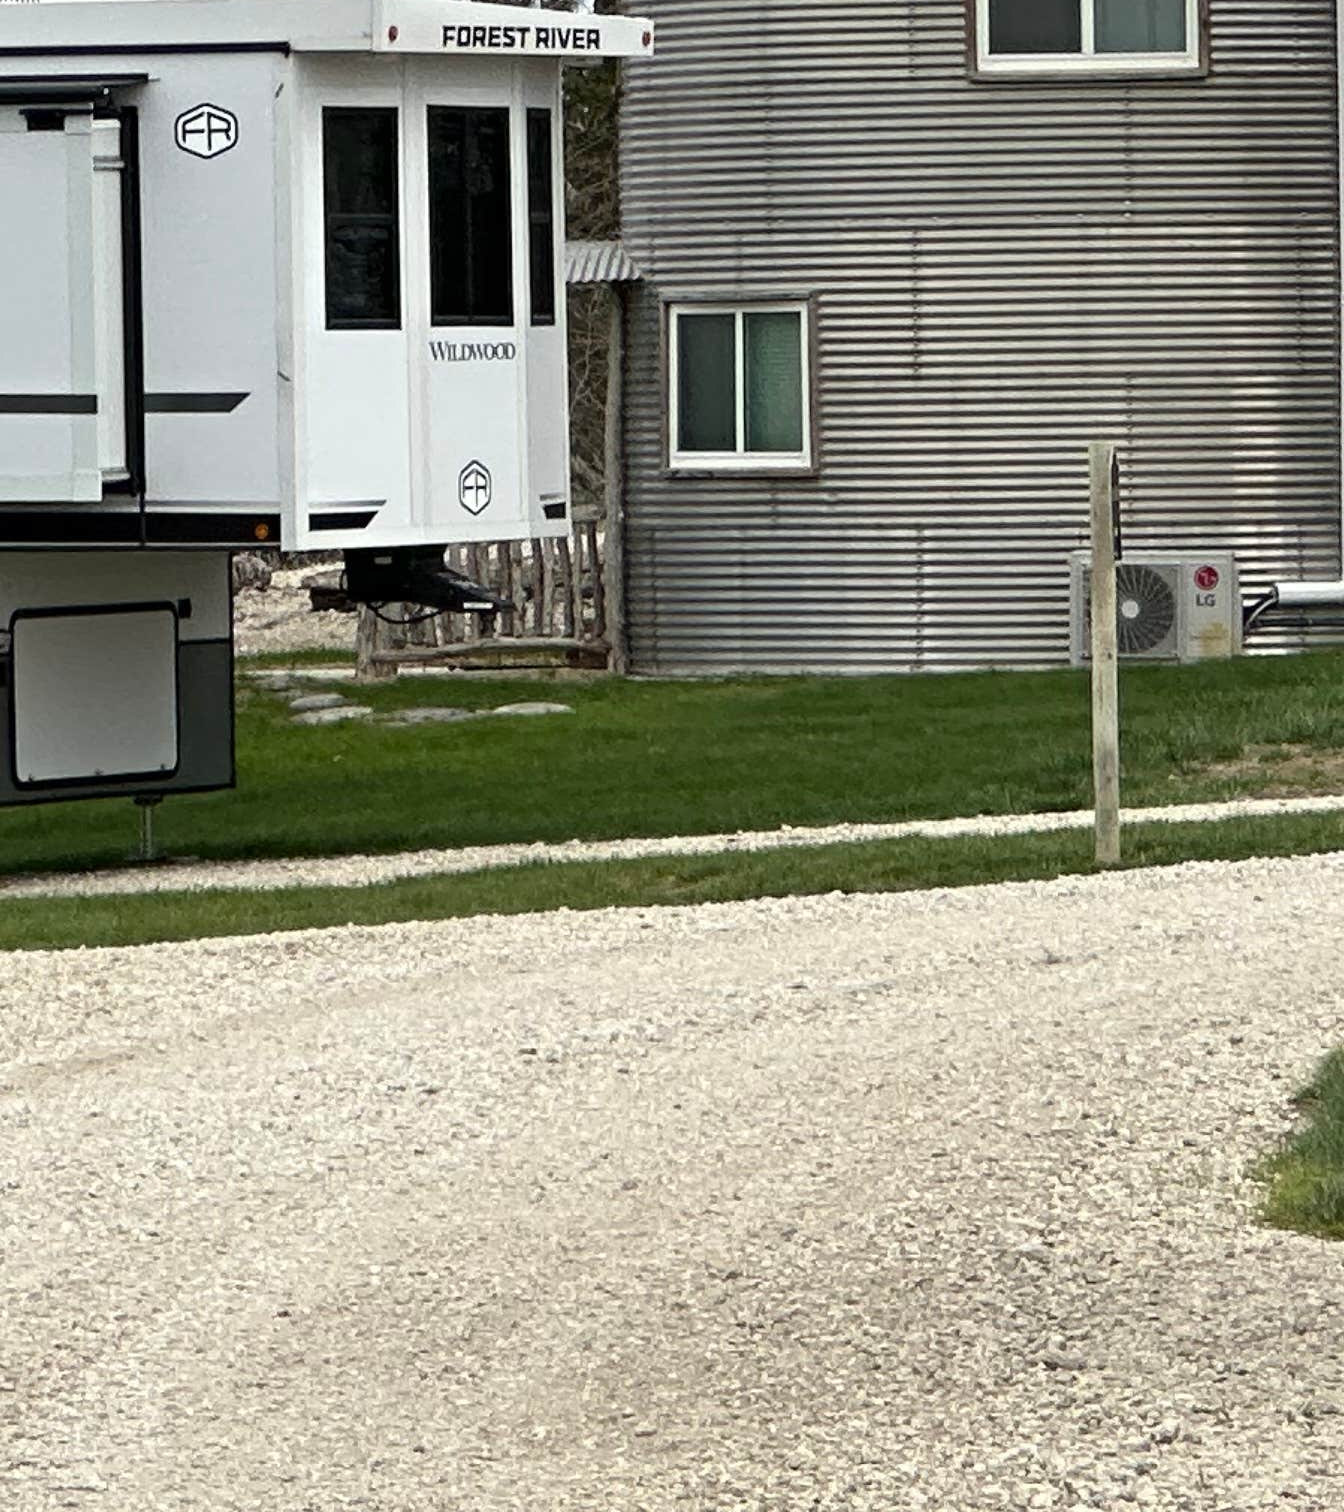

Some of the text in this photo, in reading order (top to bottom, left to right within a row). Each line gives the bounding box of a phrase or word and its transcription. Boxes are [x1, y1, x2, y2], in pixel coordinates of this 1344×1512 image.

[442, 24, 601, 50] FOREST RIVER
[1196, 593, 1216, 607] LG
